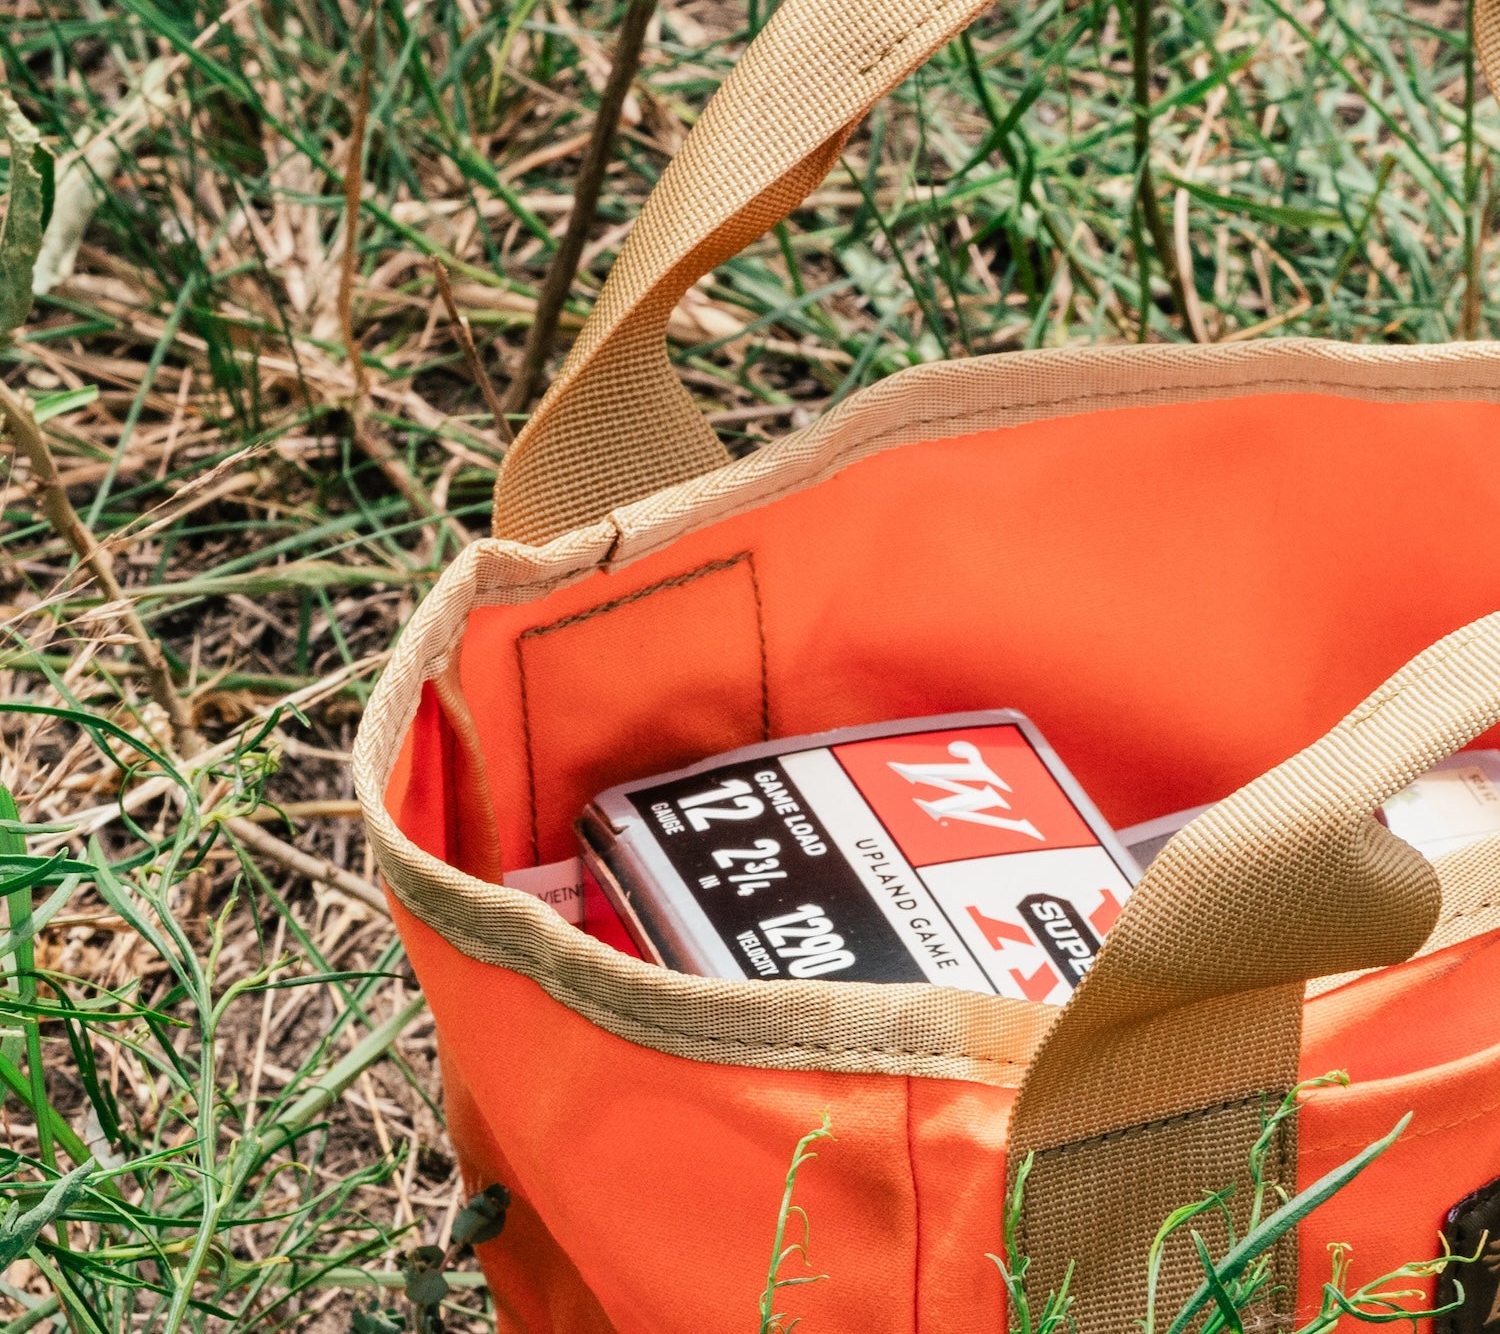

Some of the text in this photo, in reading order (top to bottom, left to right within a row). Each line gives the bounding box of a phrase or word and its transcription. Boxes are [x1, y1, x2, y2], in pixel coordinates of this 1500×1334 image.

[754, 770, 828, 857] GAME LOAD
[886, 740, 1047, 842] W
[538, 883, 583, 904] VIETN
[651, 802, 780, 976] GAUGE IN VELOCITY
[677, 778, 765, 832] 12
[758, 903, 856, 979] 1290
[855, 838, 960, 969] UPLAND GAME
[1030, 900, 1096, 977] SUPE
